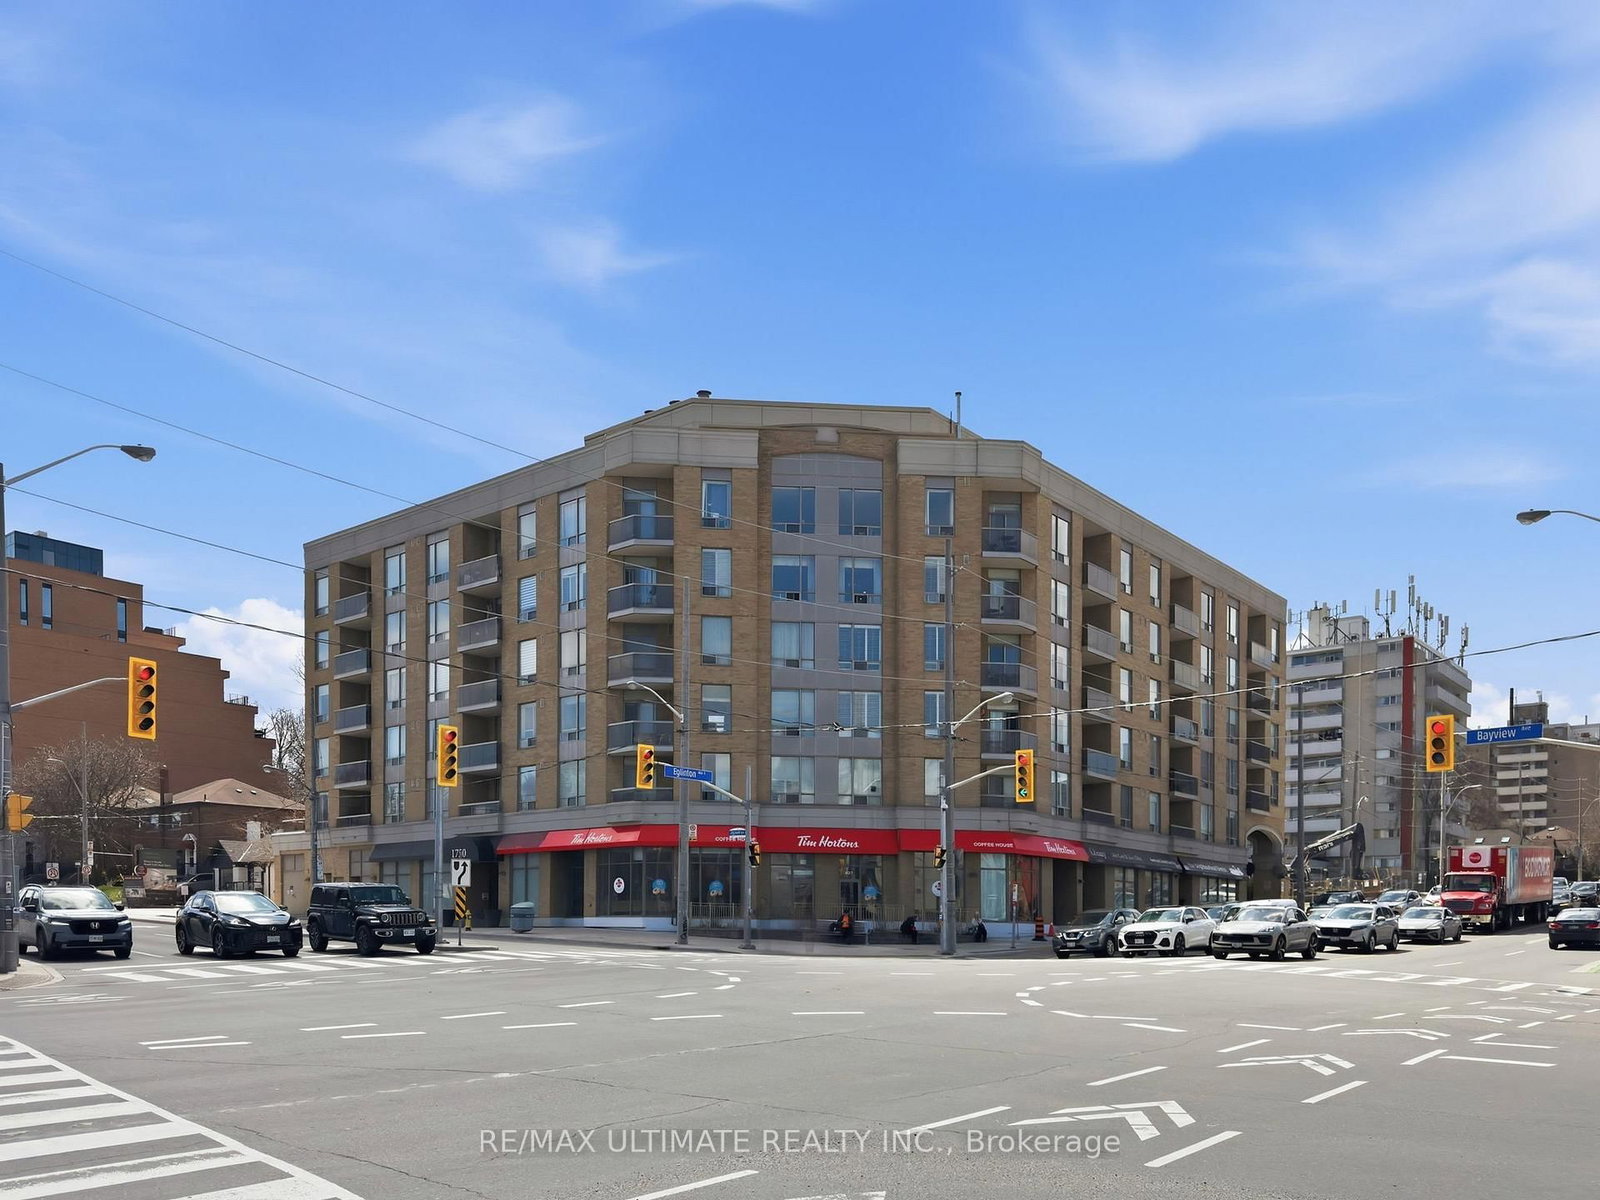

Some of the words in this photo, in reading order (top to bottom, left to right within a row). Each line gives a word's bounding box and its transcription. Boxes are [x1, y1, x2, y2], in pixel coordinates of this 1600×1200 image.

[1477, 728, 1516, 741] Bayview
[673, 767, 697, 778] Eglinton
[583, 832, 613, 844] Hortons
[796, 835, 817, 848] Tim
[818, 835, 860, 849] Hortons
[1043, 841, 1057, 852] Tim
[1055, 843, 1077, 856] Hortons
